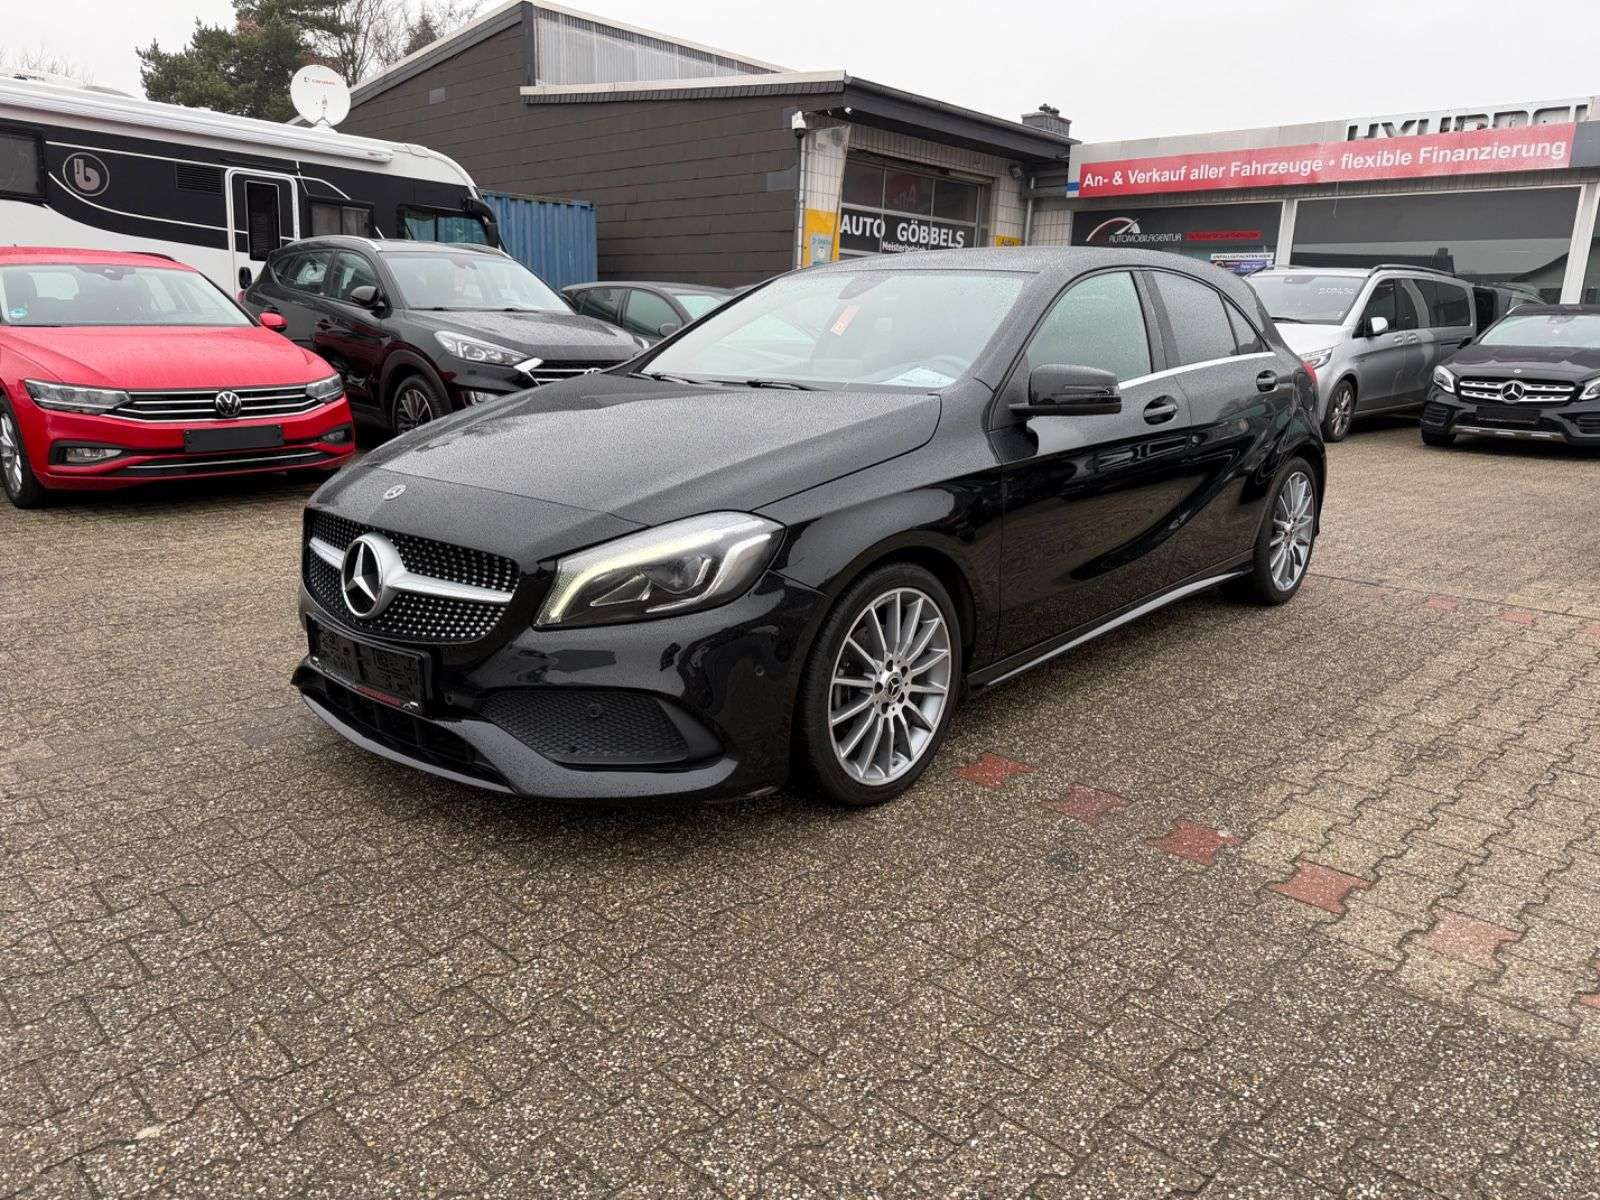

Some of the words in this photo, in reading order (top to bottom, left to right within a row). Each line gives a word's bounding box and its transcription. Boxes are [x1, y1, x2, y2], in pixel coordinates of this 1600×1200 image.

[1083, 173, 1108, 188] An-
[1112, 170, 1124, 186] &
[1128, 165, 1187, 185] Verkauf
[1190, 164, 1226, 180] aller
[1230, 159, 1323, 178] Fahrzeuge
[1341, 149, 1412, 170] flexible
[1418, 140, 1567, 164] Finanzierung
[840, 214, 886, 239] AUTO
[897, 219, 964, 248] GÖBBELS
